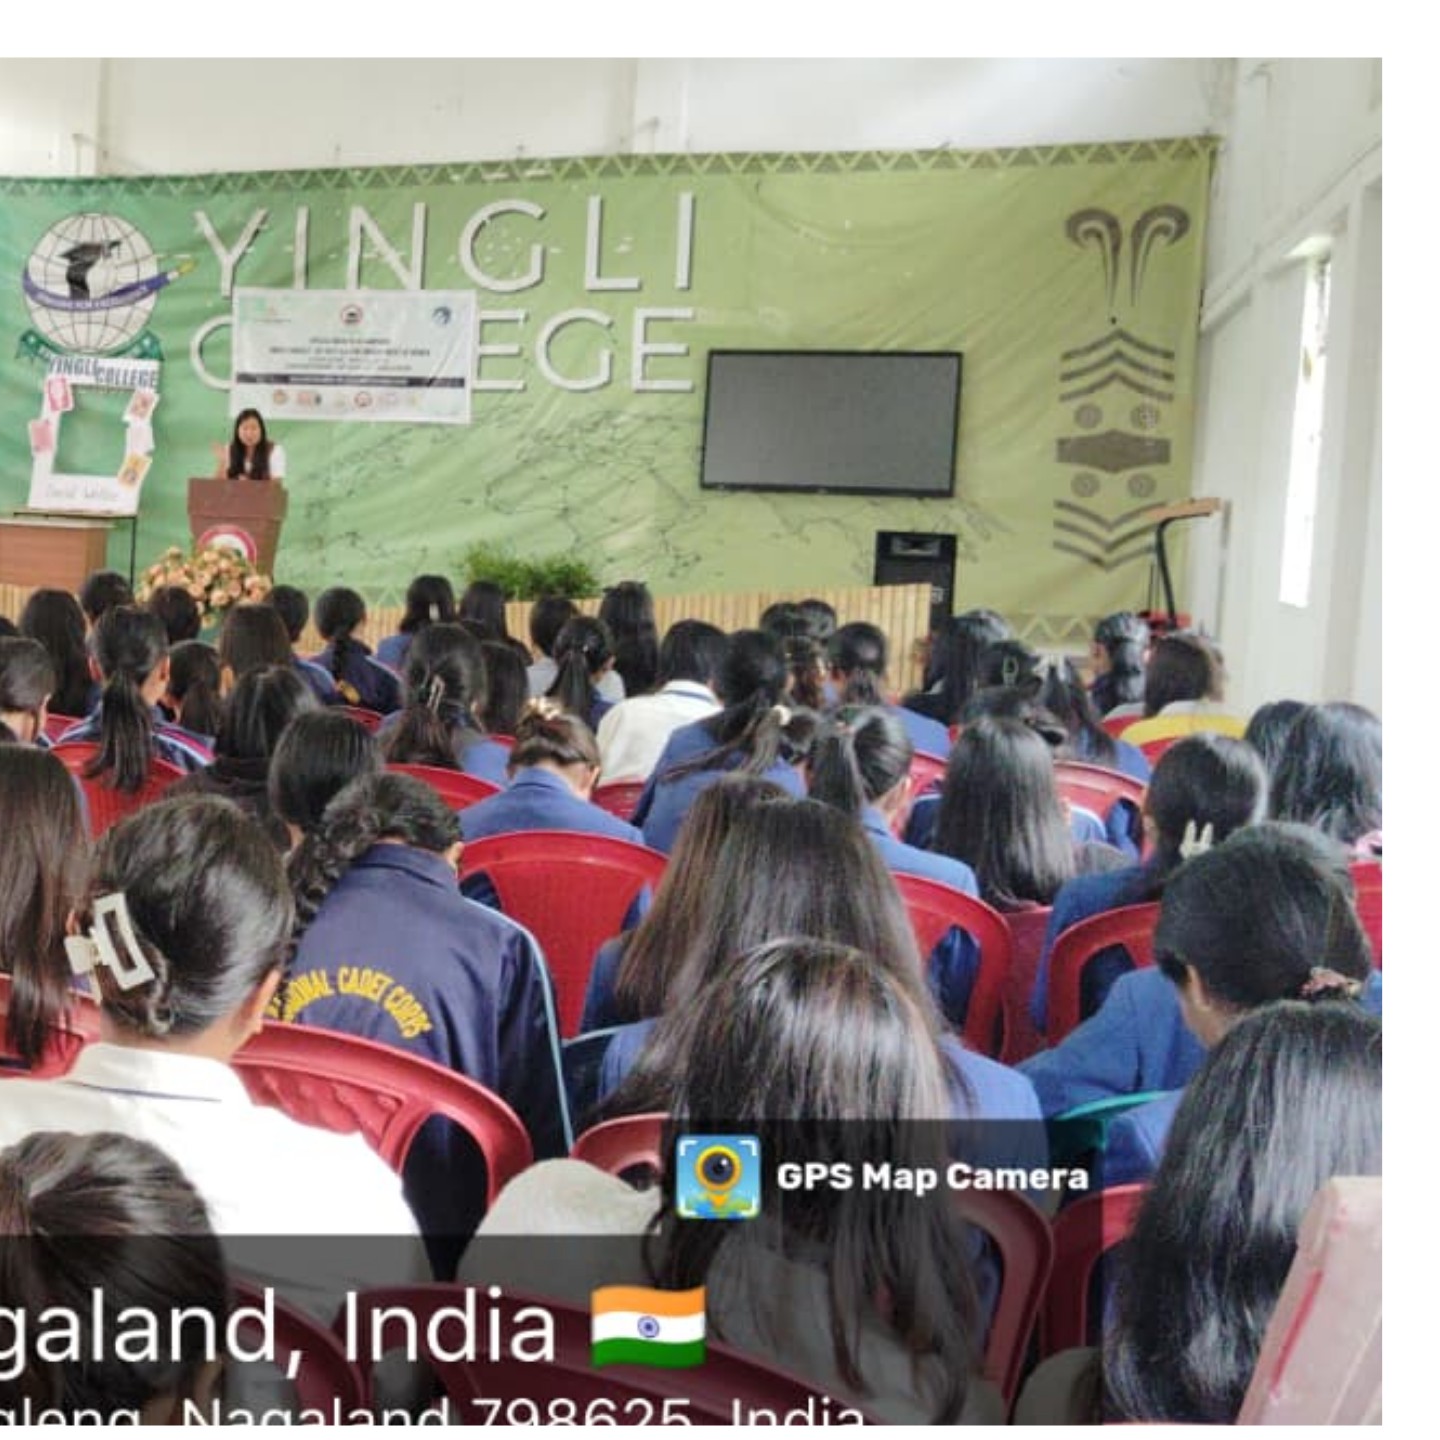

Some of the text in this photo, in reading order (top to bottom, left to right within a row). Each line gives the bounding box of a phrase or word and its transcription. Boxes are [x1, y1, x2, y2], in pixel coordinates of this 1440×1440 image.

[193, 191, 696, 297] YINGLI
[337, 966, 394, 1002] CADET
[383, 985, 433, 1038] CORPS
